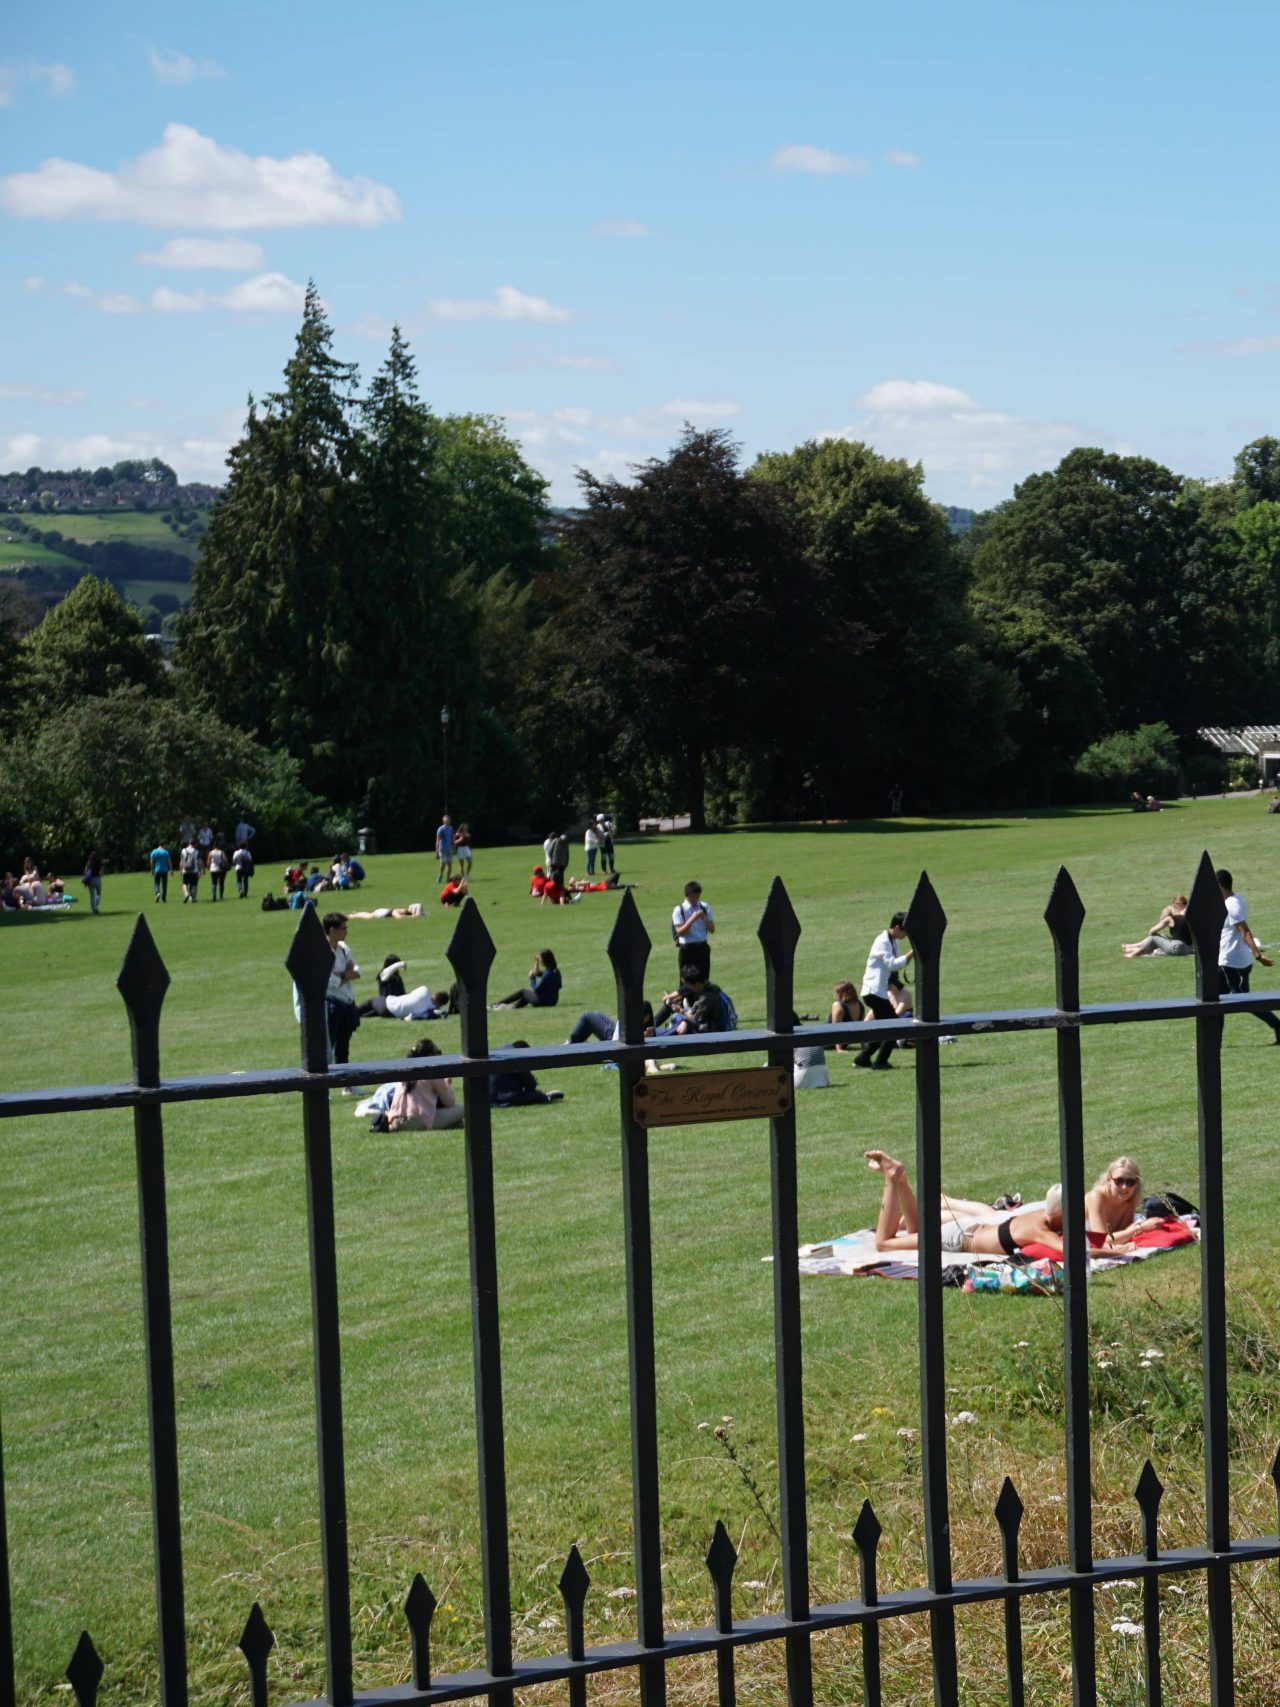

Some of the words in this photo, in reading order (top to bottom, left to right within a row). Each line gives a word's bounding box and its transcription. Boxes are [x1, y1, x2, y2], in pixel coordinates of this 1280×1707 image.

[650, 1088, 674, 1106] The
[681, 1082, 729, 1107] Royal
[731, 1082, 781, 1102] Crescent
